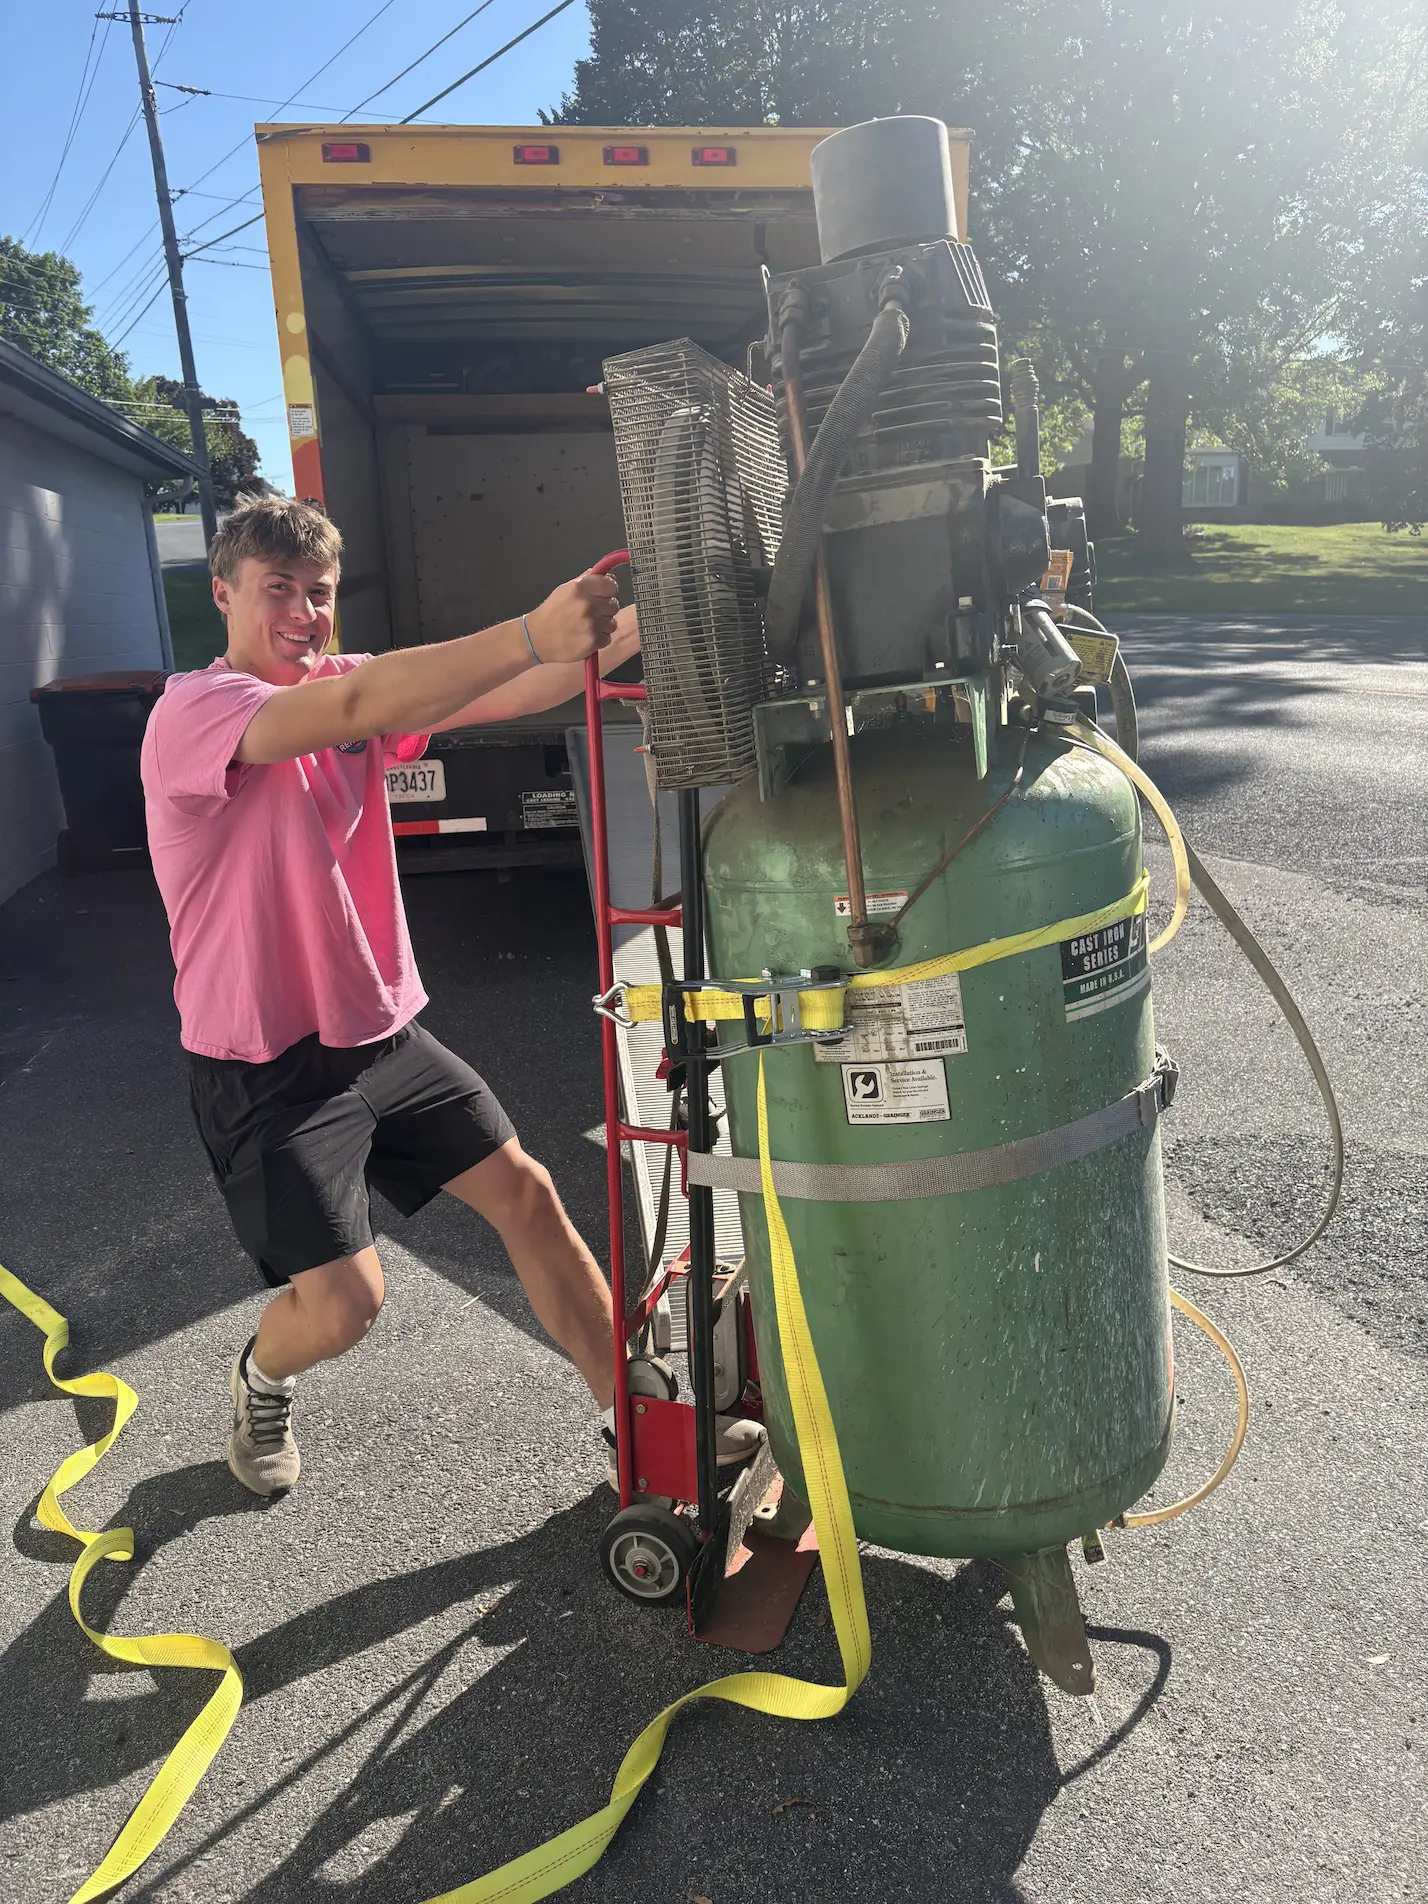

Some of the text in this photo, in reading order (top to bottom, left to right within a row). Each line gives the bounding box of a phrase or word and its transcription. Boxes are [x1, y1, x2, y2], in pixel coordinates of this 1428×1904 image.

[1070, 933, 1099, 957] CAST
[1103, 922, 1125, 946] IRON
[1083, 945, 1119, 971] SERIES
[1080, 979, 1098, 994] MADE
[1099, 976, 1107, 988] IN
[889, 1069, 921, 1077] Installation
